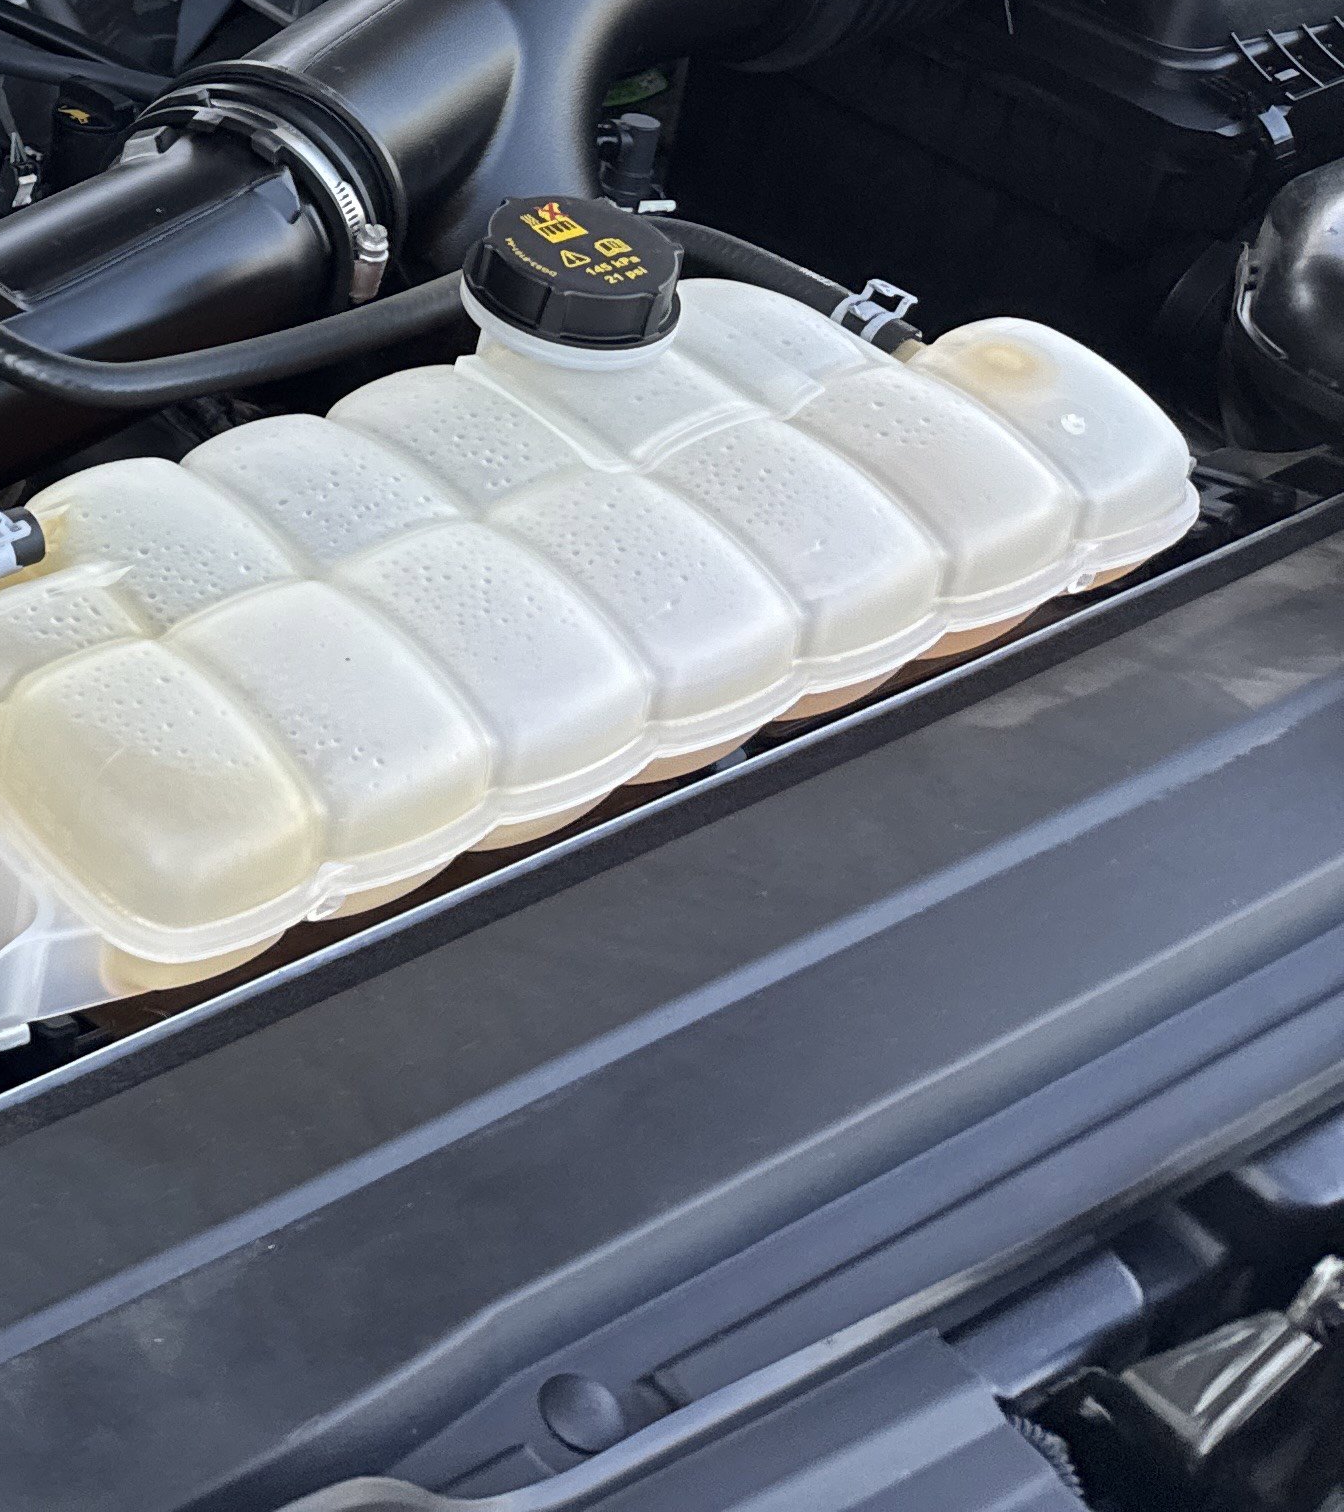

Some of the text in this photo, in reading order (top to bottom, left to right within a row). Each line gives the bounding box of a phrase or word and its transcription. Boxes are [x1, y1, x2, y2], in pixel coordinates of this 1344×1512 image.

[585, 254, 642, 276] 145 kPa
[603, 265, 648, 285] 21 psi
